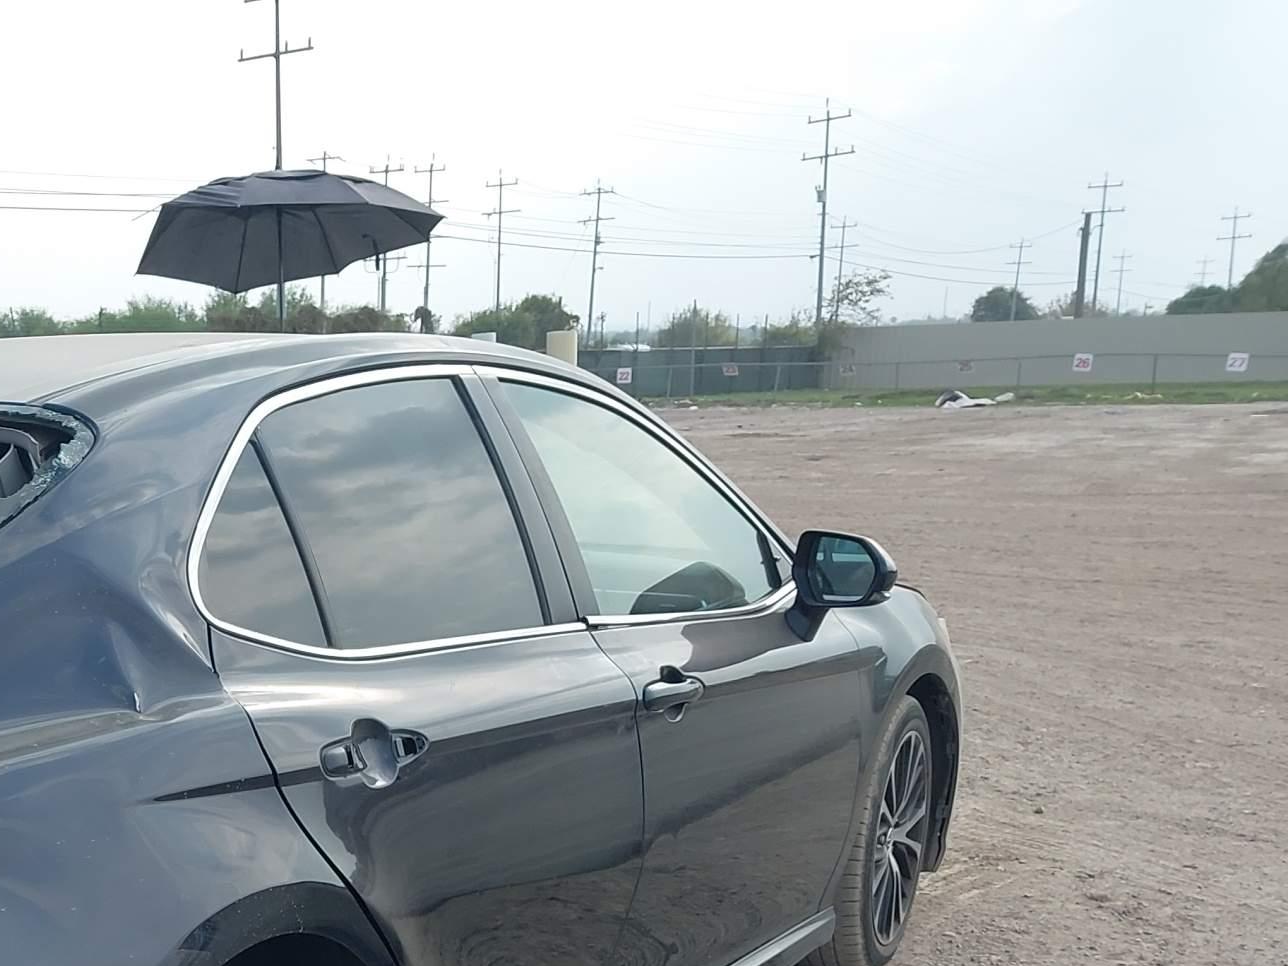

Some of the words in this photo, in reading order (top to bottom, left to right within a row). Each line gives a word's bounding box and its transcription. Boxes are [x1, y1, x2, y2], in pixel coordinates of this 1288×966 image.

[1075, 357, 1089, 368] 26
[1228, 357, 1245, 368] 27
[618, 371, 629, 381] 22
